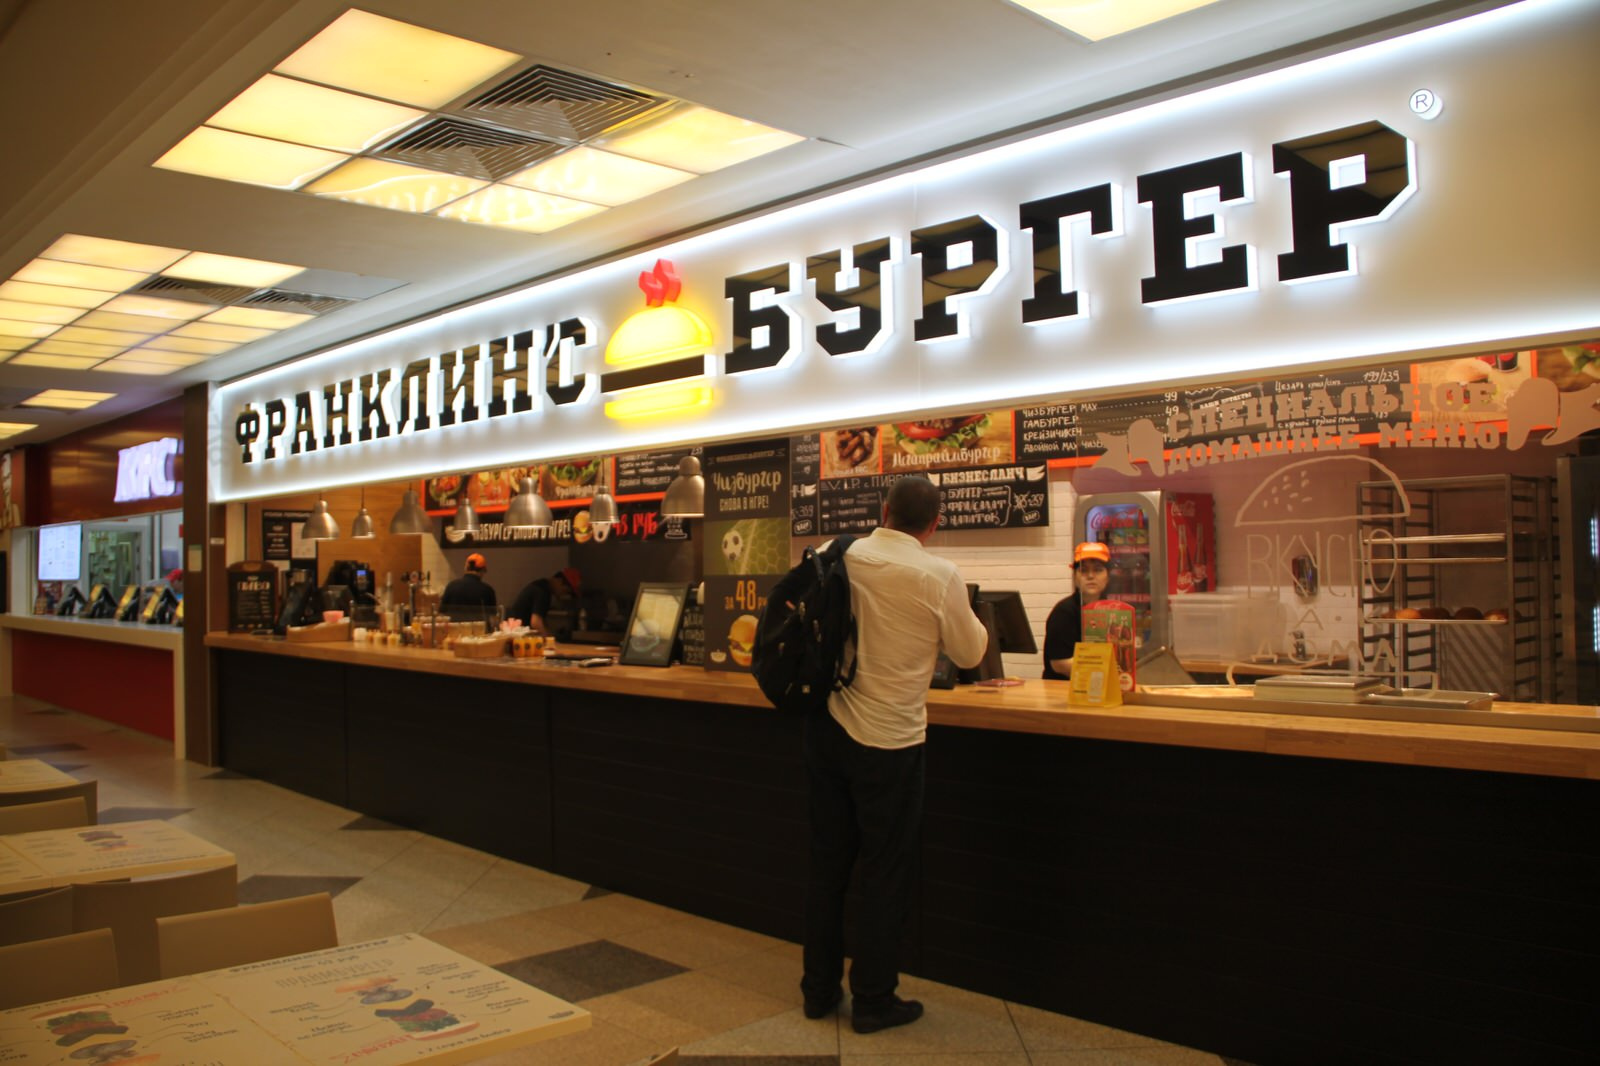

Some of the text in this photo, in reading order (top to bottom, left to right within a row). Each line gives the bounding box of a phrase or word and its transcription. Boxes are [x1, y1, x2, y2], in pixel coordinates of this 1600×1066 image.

[724, 119, 1414, 376] БУРГЕР
[1022, 403, 1076, 418] ЧИЗБУРГЕР
[1164, 391, 1178, 402] 99
[1166, 381, 1498, 442] СПЕЦИАЛЬНОЕ
[1023, 415, 1079, 429] ГАМБУРГЕР
[1168, 421, 1500, 475] ДОМАШНЕЕ МЕНЮ
[711, 470, 782, 495] Чизбургер
[871, 473, 914, 488] ПИВ
[736, 580, 757, 611] 48
[757, 596, 768, 611] РУ
